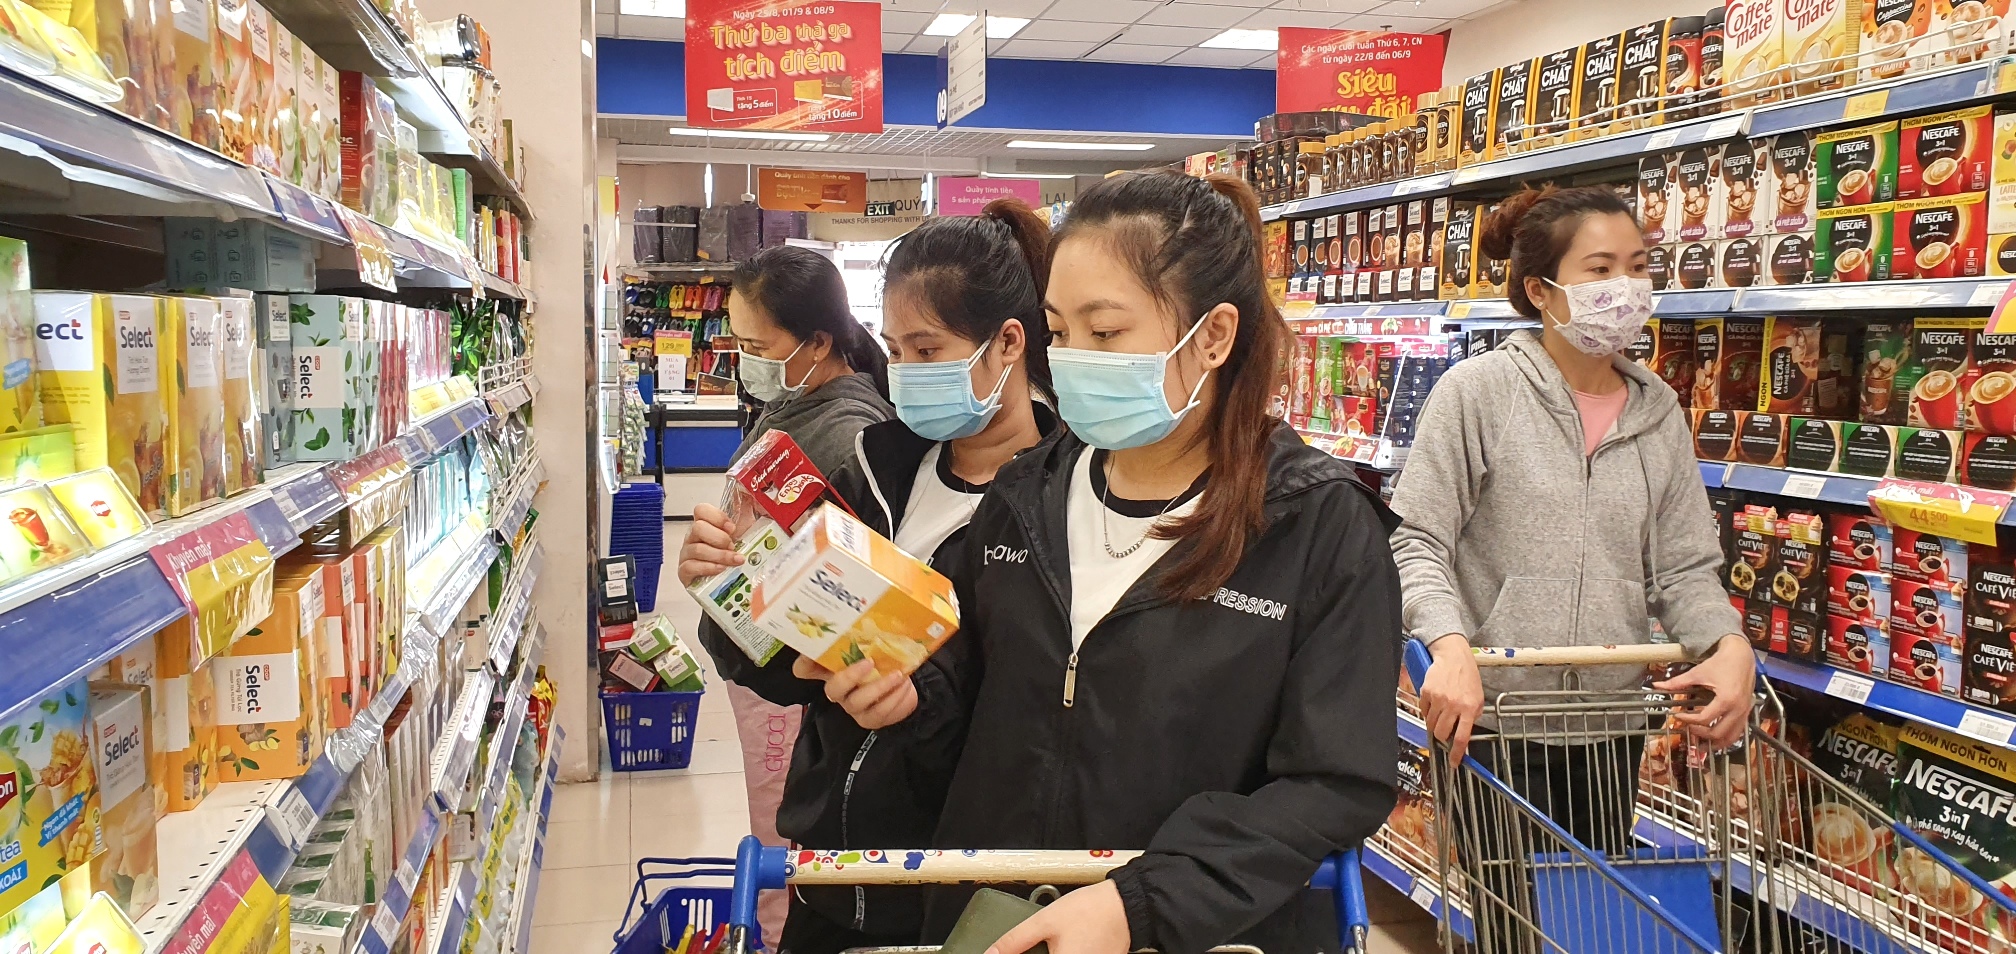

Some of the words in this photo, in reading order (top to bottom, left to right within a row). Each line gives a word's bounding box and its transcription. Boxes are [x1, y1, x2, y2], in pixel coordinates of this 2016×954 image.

[733, 10, 755, 20] Ngày
[782, 8, 803, 17] 01/9
[805, 7, 812, 15] &
[814, 6, 835, 15] 08/9
[1726, 0, 1773, 39] Coffee
[1797, 0, 1834, 32] mate
[1876, 3, 1913, 22] Cappuccino
[710, 22, 757, 47] Thứ
[761, 22, 788, 44] ba
[795, 20, 823, 39] thả
[828, 22, 849, 41] ga
[1736, 13, 1773, 50] mate
[1302, 44, 1316, 54] Các
[1317, 43, 1337, 55] ngày
[1339, 40, 1355, 51] cuối
[1357, 39, 1375, 50] tuần
[1377, 37, 1393, 48] Thứ
[1403, 38, 1410, 48] 7,
[1412, 37, 1423, 46] CN
[1625, 38, 1659, 66] CHẤT
[724, 52, 773, 79] tích
[780, 41, 843, 73] điểm
[1323, 55, 1334, 64] từ
[1336, 54, 1353, 66] ngày
[1355, 52, 1374, 62] 22/8
[1376, 51, 1391, 60] đến
[1392, 50, 1411, 60] 06/9
[1586, 51, 1617, 76] CHẤT
[1337, 66, 1394, 96] Siêu
[1541, 62, 1572, 88] CHẤT
[753, 99, 759, 108] 5
[759, 99, 774, 107] điểm
[827, 109, 840, 119] 10
[840, 110, 858, 118] điểm
[937, 89, 947, 124] 09
[1904, 119, 1922, 127] THƠM
[1922, 116, 1942, 125] NGON
[1818, 133, 1836, 141] THƠM
[951, 196, 957, 204] 5
[965, 185, 984, 196] Quầy
[985, 186, 999, 194] tính
[868, 204, 891, 215] EXIT
[895, 196, 921, 211] QUÝ
[1819, 209, 1835, 218] THƠM
[1835, 207, 1852, 216] NGON
[1852, 206, 1866, 215] HƠN
[1896, 201, 1915, 209] THƠM
[832, 218, 856, 226] THANKS
[857, 217, 870, 225] FOR
[871, 216, 904, 225] SHOPPING
[905, 216, 922, 224] WITH
[120, 325, 154, 349] Select
[661, 342, 674, 350] 129
[299, 355, 313, 400] Select
[1759, 382, 1768, 407] NGON
[750, 468, 767, 491] Good
[779, 478, 798, 498] Enjoy
[1918, 486, 1936, 495] mãi
[165, 542, 198, 571] Khuyến
[809, 567, 868, 613] Select
[1975, 581, 1998, 594] CAFÉ
[1973, 653, 1996, 667] CAFÉ
[246, 664, 262, 714] Select
[1840, 721, 1869, 742] NGON
[105, 724, 140, 767] Select
[765, 713, 786, 772] GUCCI
[1905, 725, 1941, 747] THƠM
[1940, 740, 1976, 761] NGON
[1977, 753, 2008, 773] HƠN
[1939, 806, 1971, 831] 3in1
[1951, 829, 1966, 846] xay
